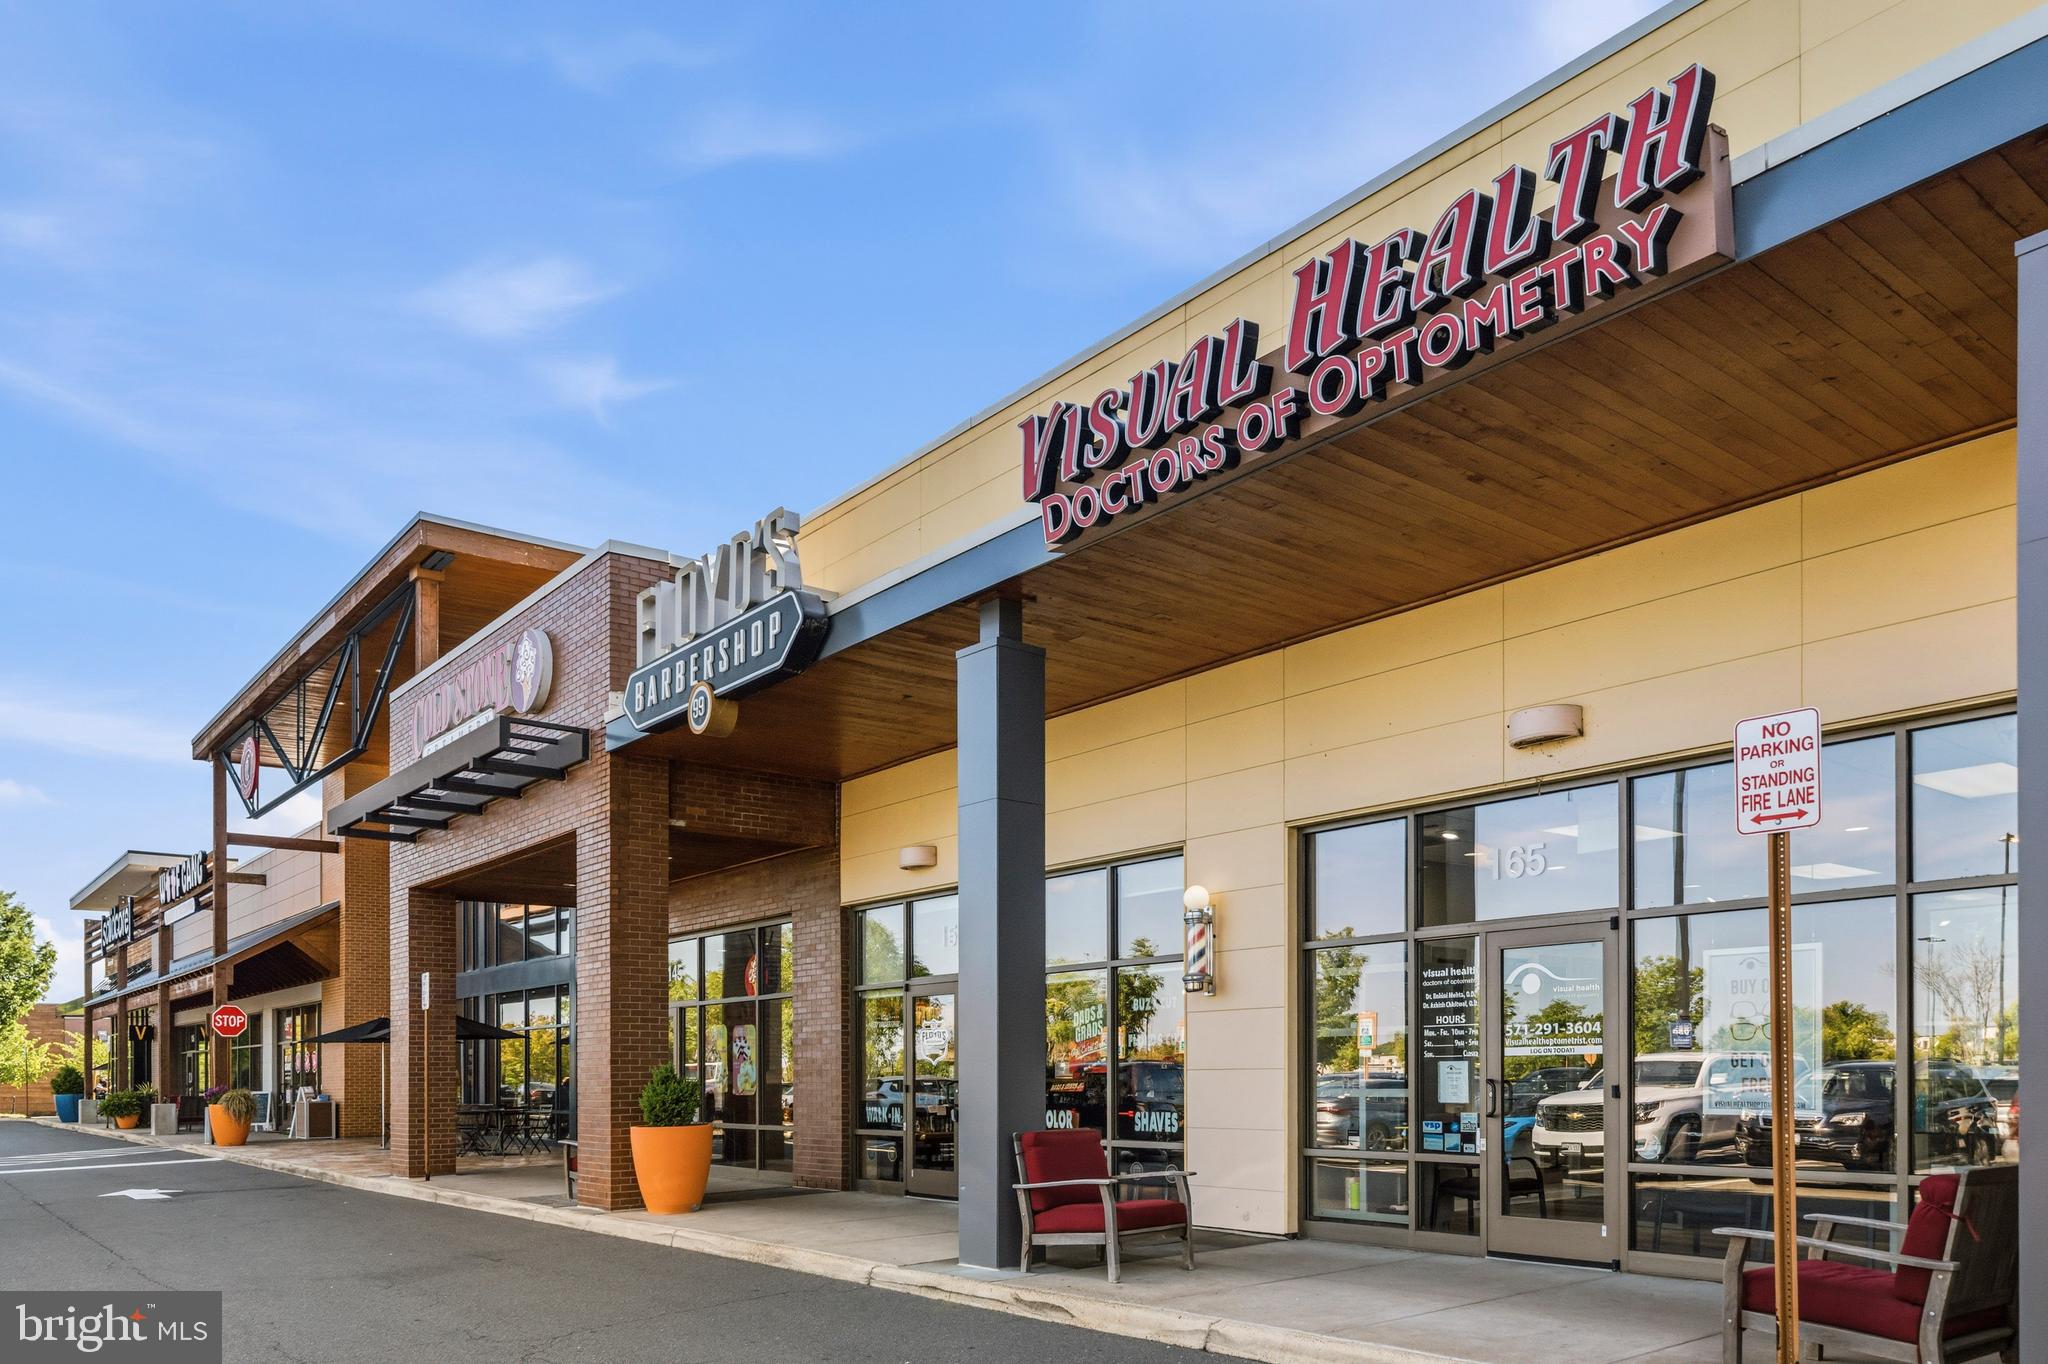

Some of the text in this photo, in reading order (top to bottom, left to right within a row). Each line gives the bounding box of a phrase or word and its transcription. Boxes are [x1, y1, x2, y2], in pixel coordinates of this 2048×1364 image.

[1018, 62, 1713, 503] VISUAL HEALTH
[1042, 204, 1676, 545] DOCTORS OF OPTOMETRY
[634, 610, 783, 714] BARBERSHOP
[692, 695, 706, 719] 99
[1762, 721, 1791, 740] NO
[1741, 735, 1814, 761] PARKING
[1769, 759, 1785, 769] OR
[1741, 767, 1815, 792] STANDING
[1742, 786, 1815, 813] FIRE LANE
[1493, 842, 1546, 881] 165
[181, 850, 204, 894] GANG
[1422, 968, 1449, 978] visual
[1552, 983, 1600, 992] visual health
[1731, 979, 1757, 995] BUY
[215, 1014, 245, 1028] STOP
[1436, 1014, 1466, 1024] HOURS
[1504, 1021, 1601, 1036] 571-291-3604
[135, 1026, 147, 1041] V
[1731, 1052, 1757, 1068] GET
[865, 1106, 904, 1123] WALK-IN
[1046, 1109, 1074, 1129] OLOR
[1134, 1111, 1179, 1133] SHAVES
[1424, 1122, 1440, 1130] vsp
